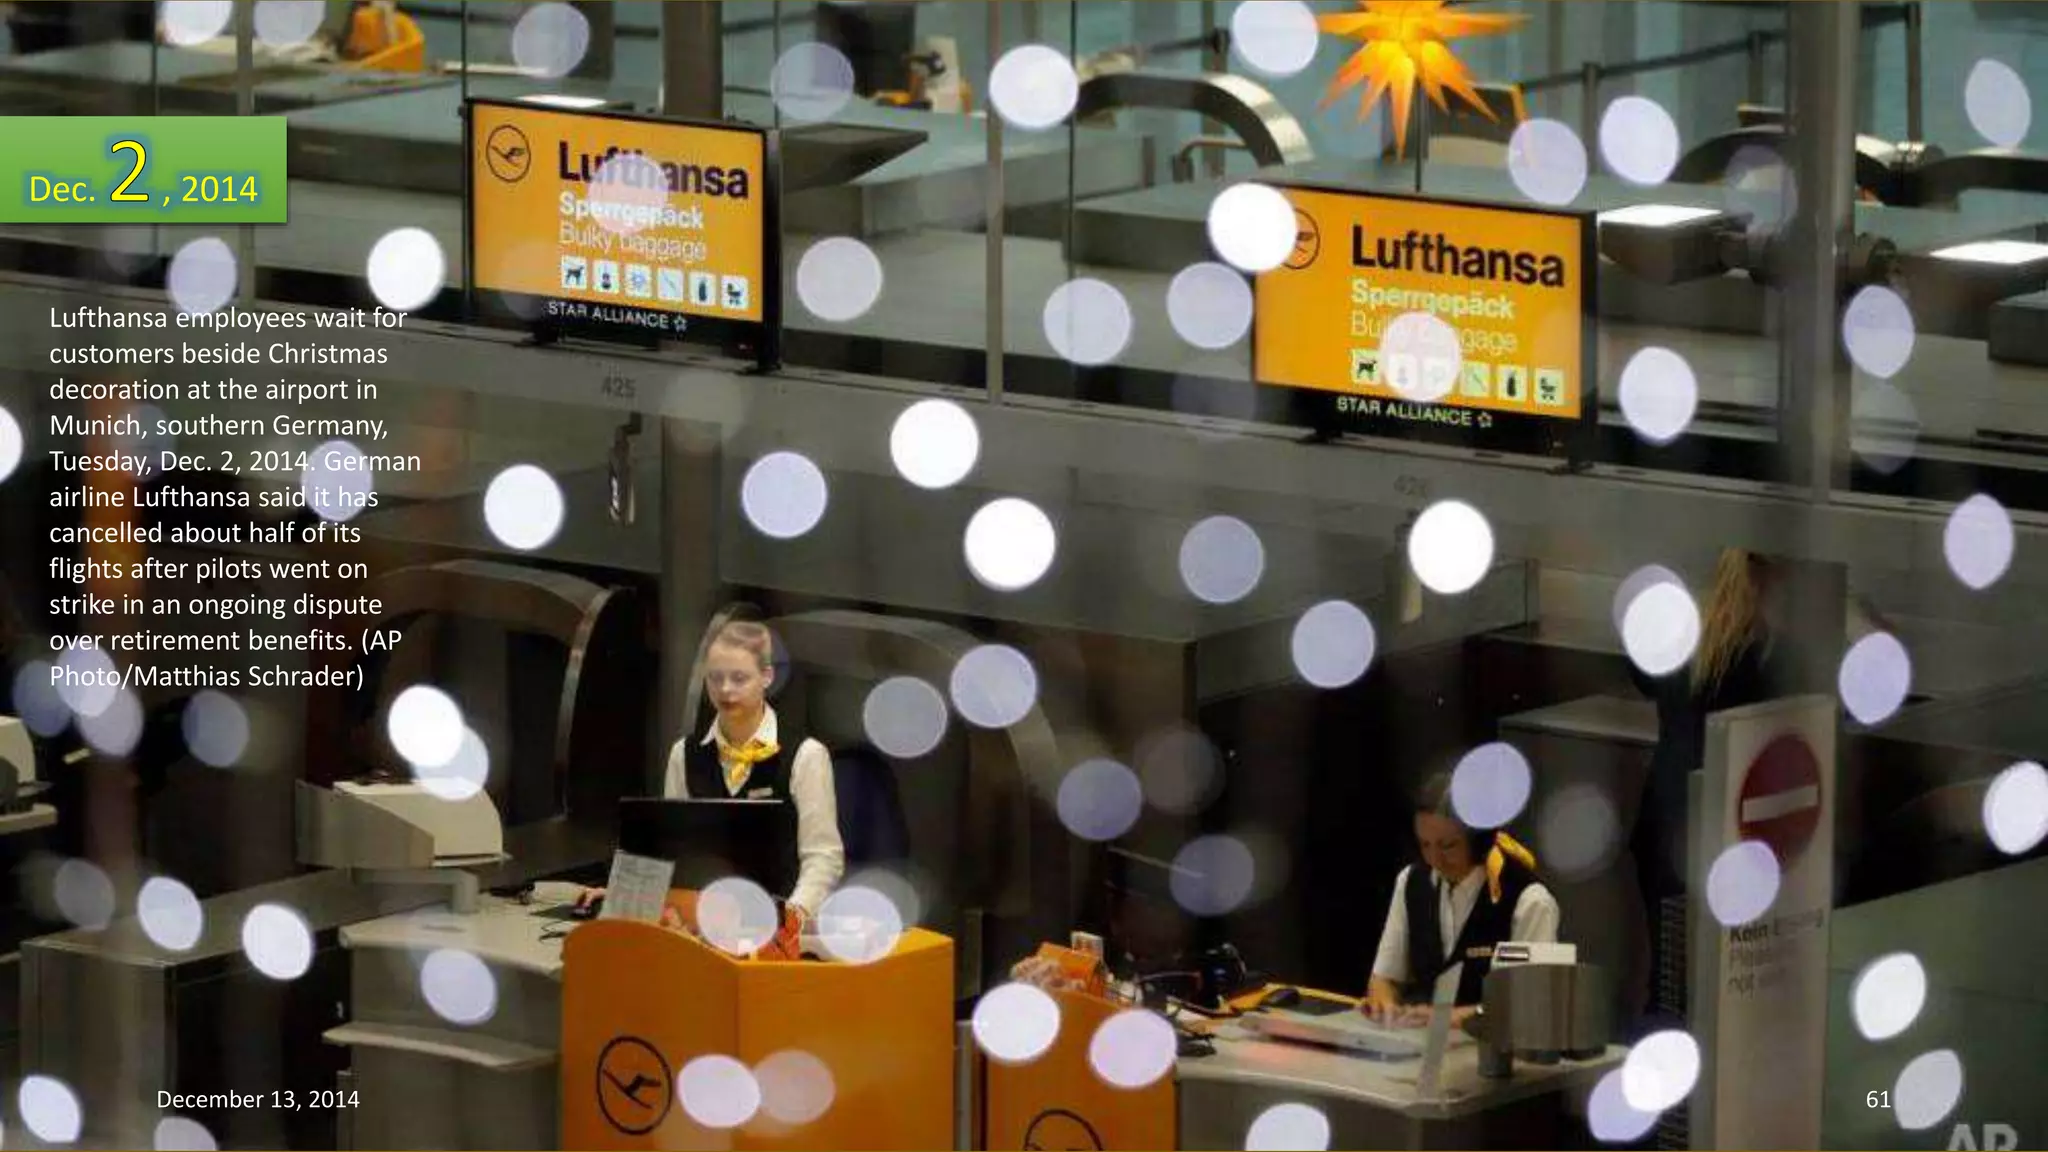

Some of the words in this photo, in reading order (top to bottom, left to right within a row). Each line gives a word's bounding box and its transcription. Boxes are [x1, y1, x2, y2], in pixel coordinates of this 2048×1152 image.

[558, 140, 750, 200] Lufthansa
[1352, 223, 1566, 289] Lufthansa
[548, 300, 587, 318] STAR
[592, 306, 668, 330] ALLIANCE
[1351, 277, 1516, 320] Sperrgepäck
[1337, 396, 1381, 415] STAR
[1385, 402, 1471, 427] ALLIANCE
